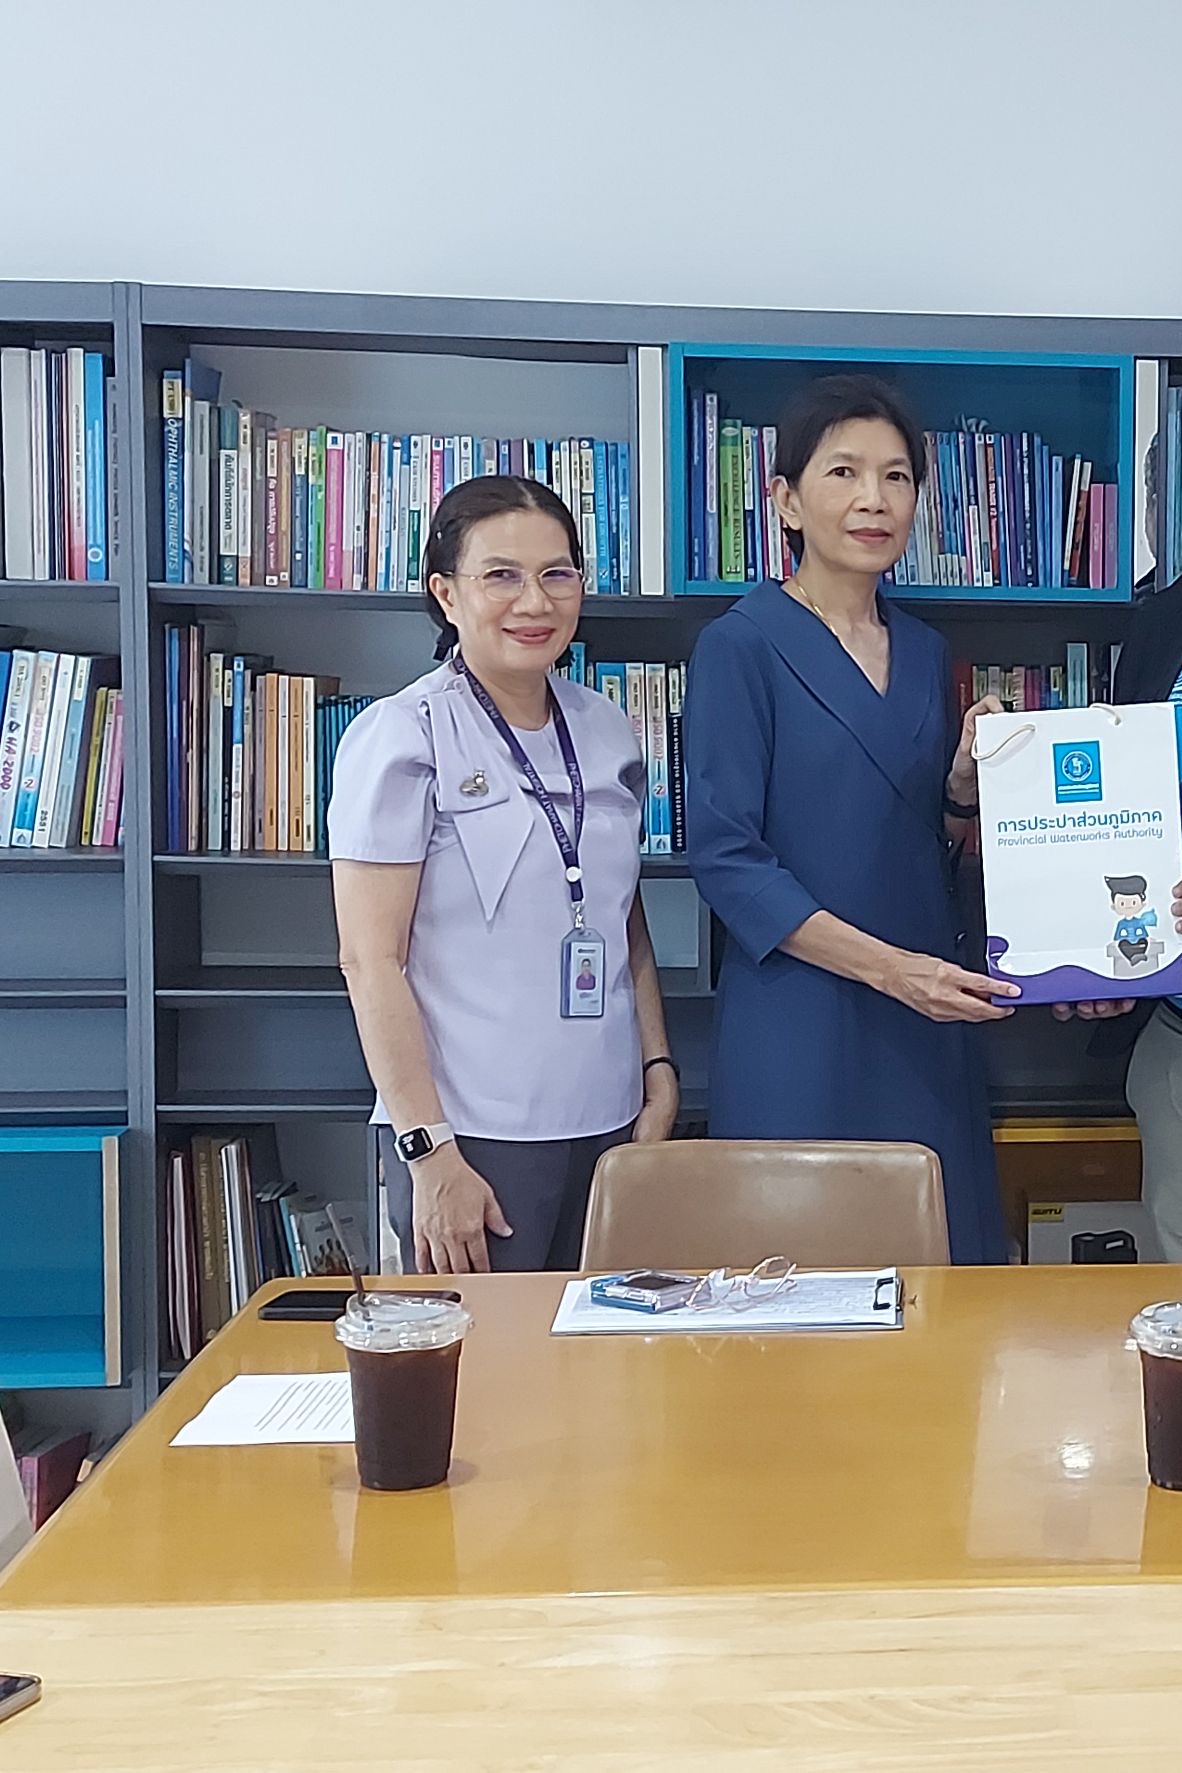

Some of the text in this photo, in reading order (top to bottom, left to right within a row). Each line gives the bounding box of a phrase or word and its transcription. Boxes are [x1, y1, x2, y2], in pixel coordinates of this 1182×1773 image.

[167, 418, 179, 491] OPHTHALMIC
[168, 492, 181, 570] INSTRUMENTS
[997, 810, 1163, 831] การประปาส่วนภูมิภาค
[998, 827, 1164, 847] Provincial Waterworks Authority
